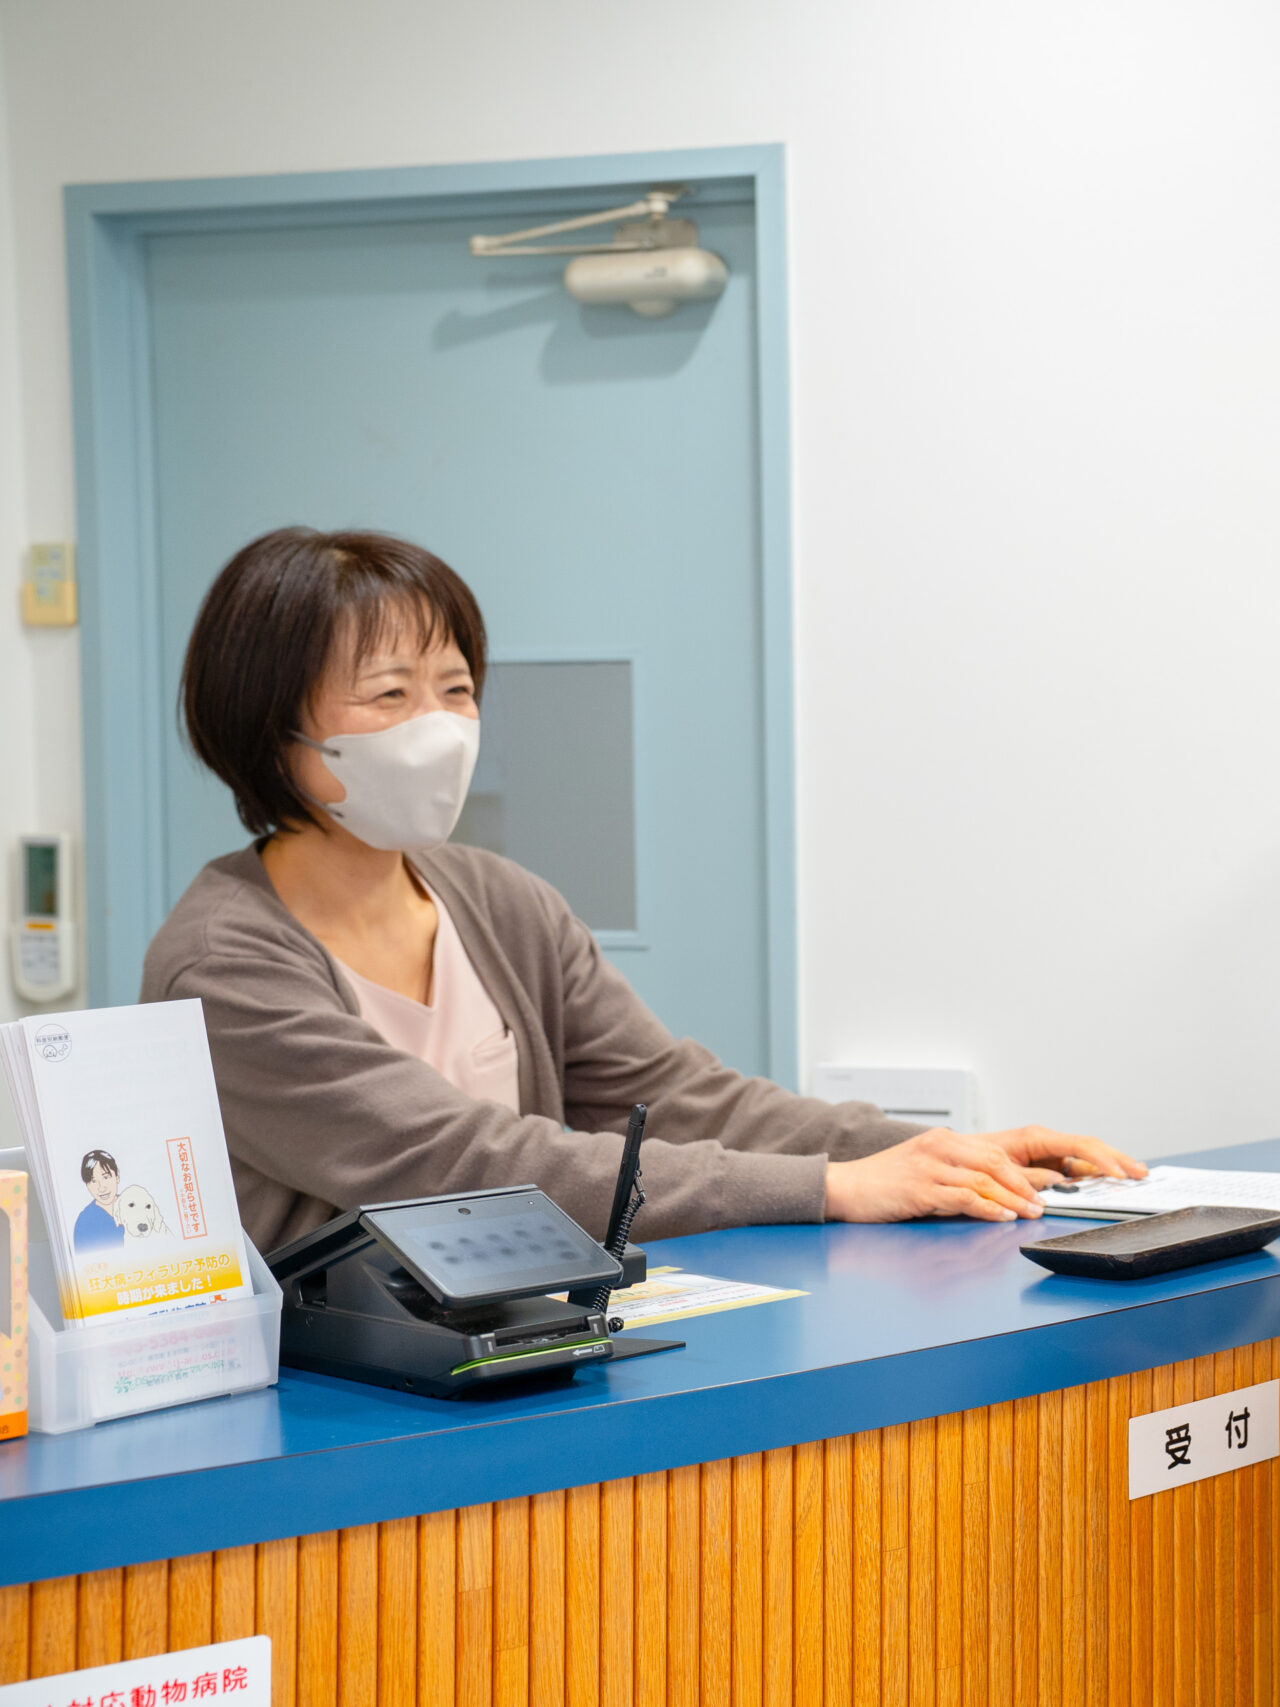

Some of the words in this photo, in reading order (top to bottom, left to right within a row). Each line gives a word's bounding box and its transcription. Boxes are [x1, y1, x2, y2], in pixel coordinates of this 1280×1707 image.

[176, 1142, 200, 1233] 大切なお知らせです
[88, 1252, 231, 1294] 狂犬病・フィラリア予防の
[115, 1274, 213, 1307] 時期が来ました！
[1164, 1406, 1251, 1471] 受付
